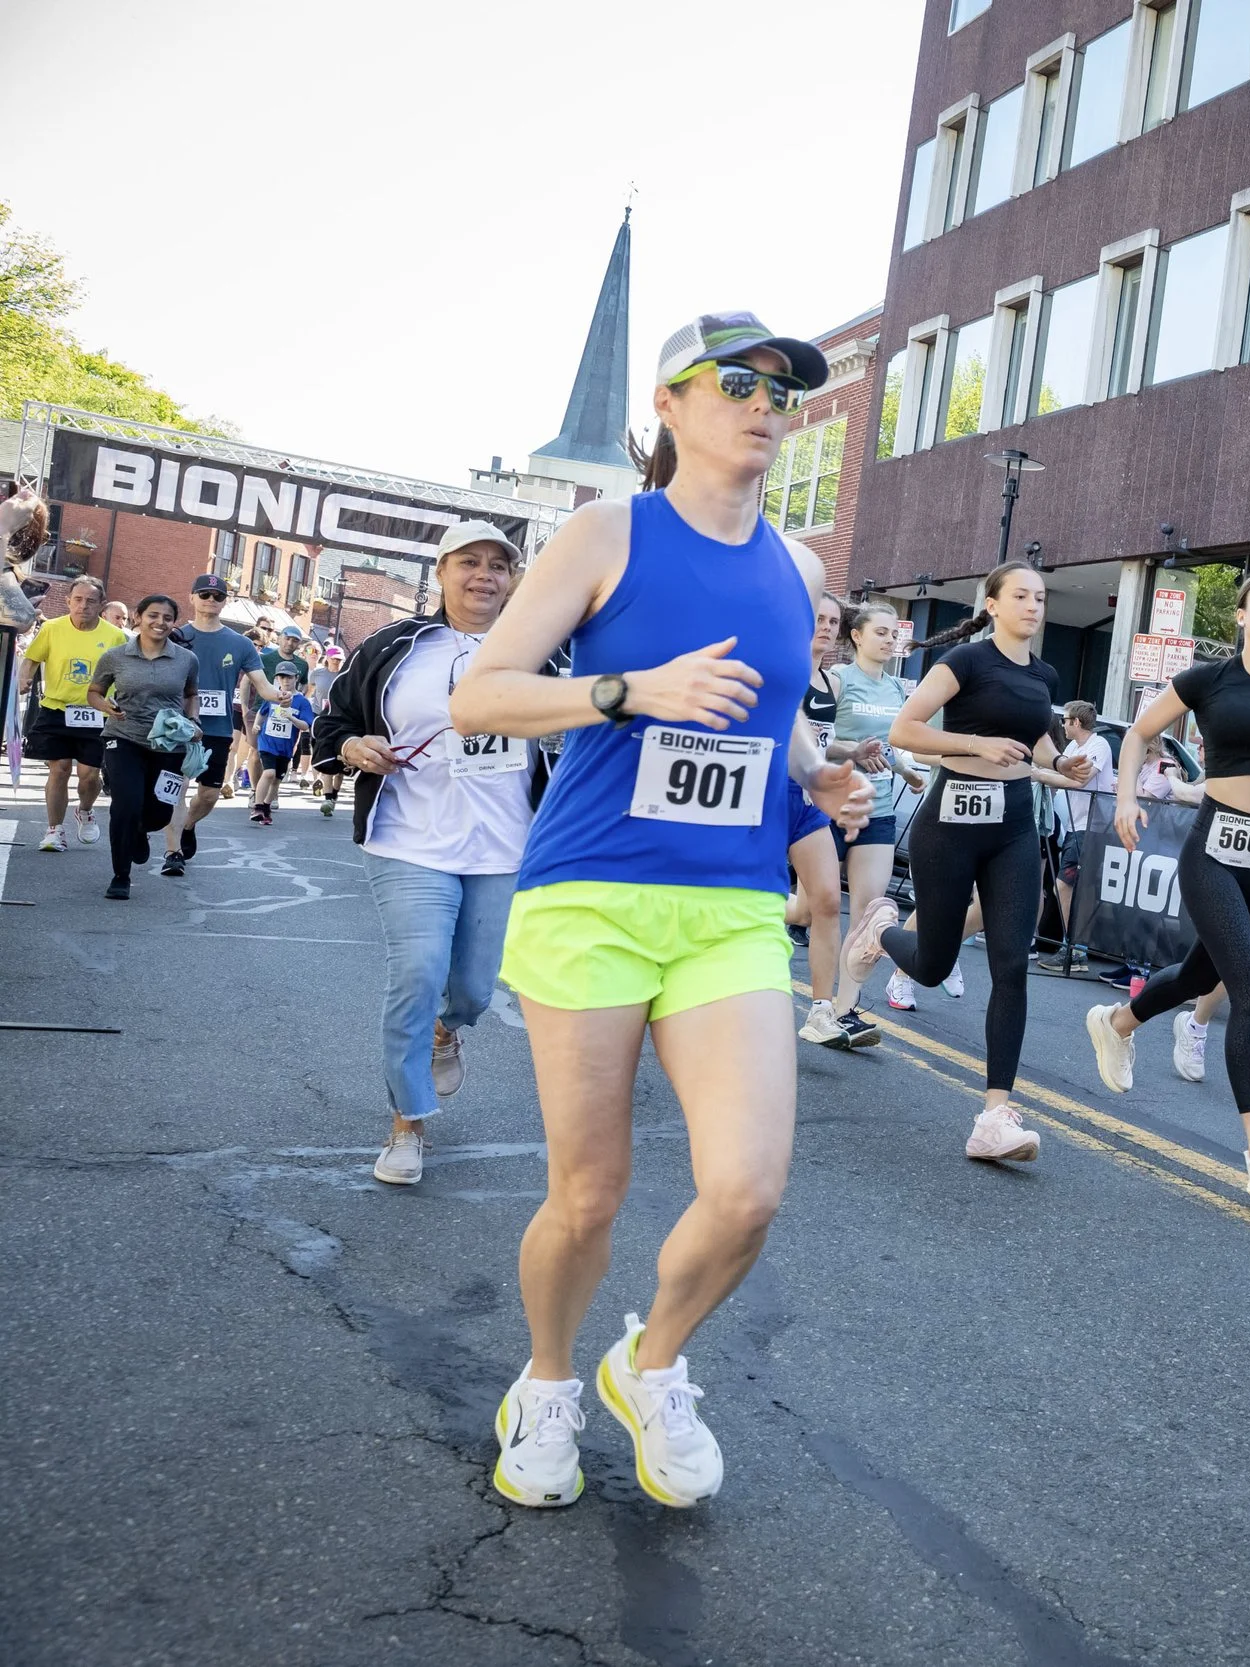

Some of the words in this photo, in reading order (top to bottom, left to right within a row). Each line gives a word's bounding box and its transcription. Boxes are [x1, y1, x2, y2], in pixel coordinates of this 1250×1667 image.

[92, 446, 462, 559] BIONIC
[1156, 608, 1180, 616] PARKING
[1167, 653, 1188, 661] PARKING
[73, 710, 96, 722] 261
[852, 702, 900, 716] BIONIC
[272, 722, 287, 733] 751
[659, 731, 749, 755] BIONIC
[164, 780, 182, 796] 371
[665, 759, 747, 809] 901
[950, 782, 990, 791] BIONIC
[954, 794, 992, 817] 561
